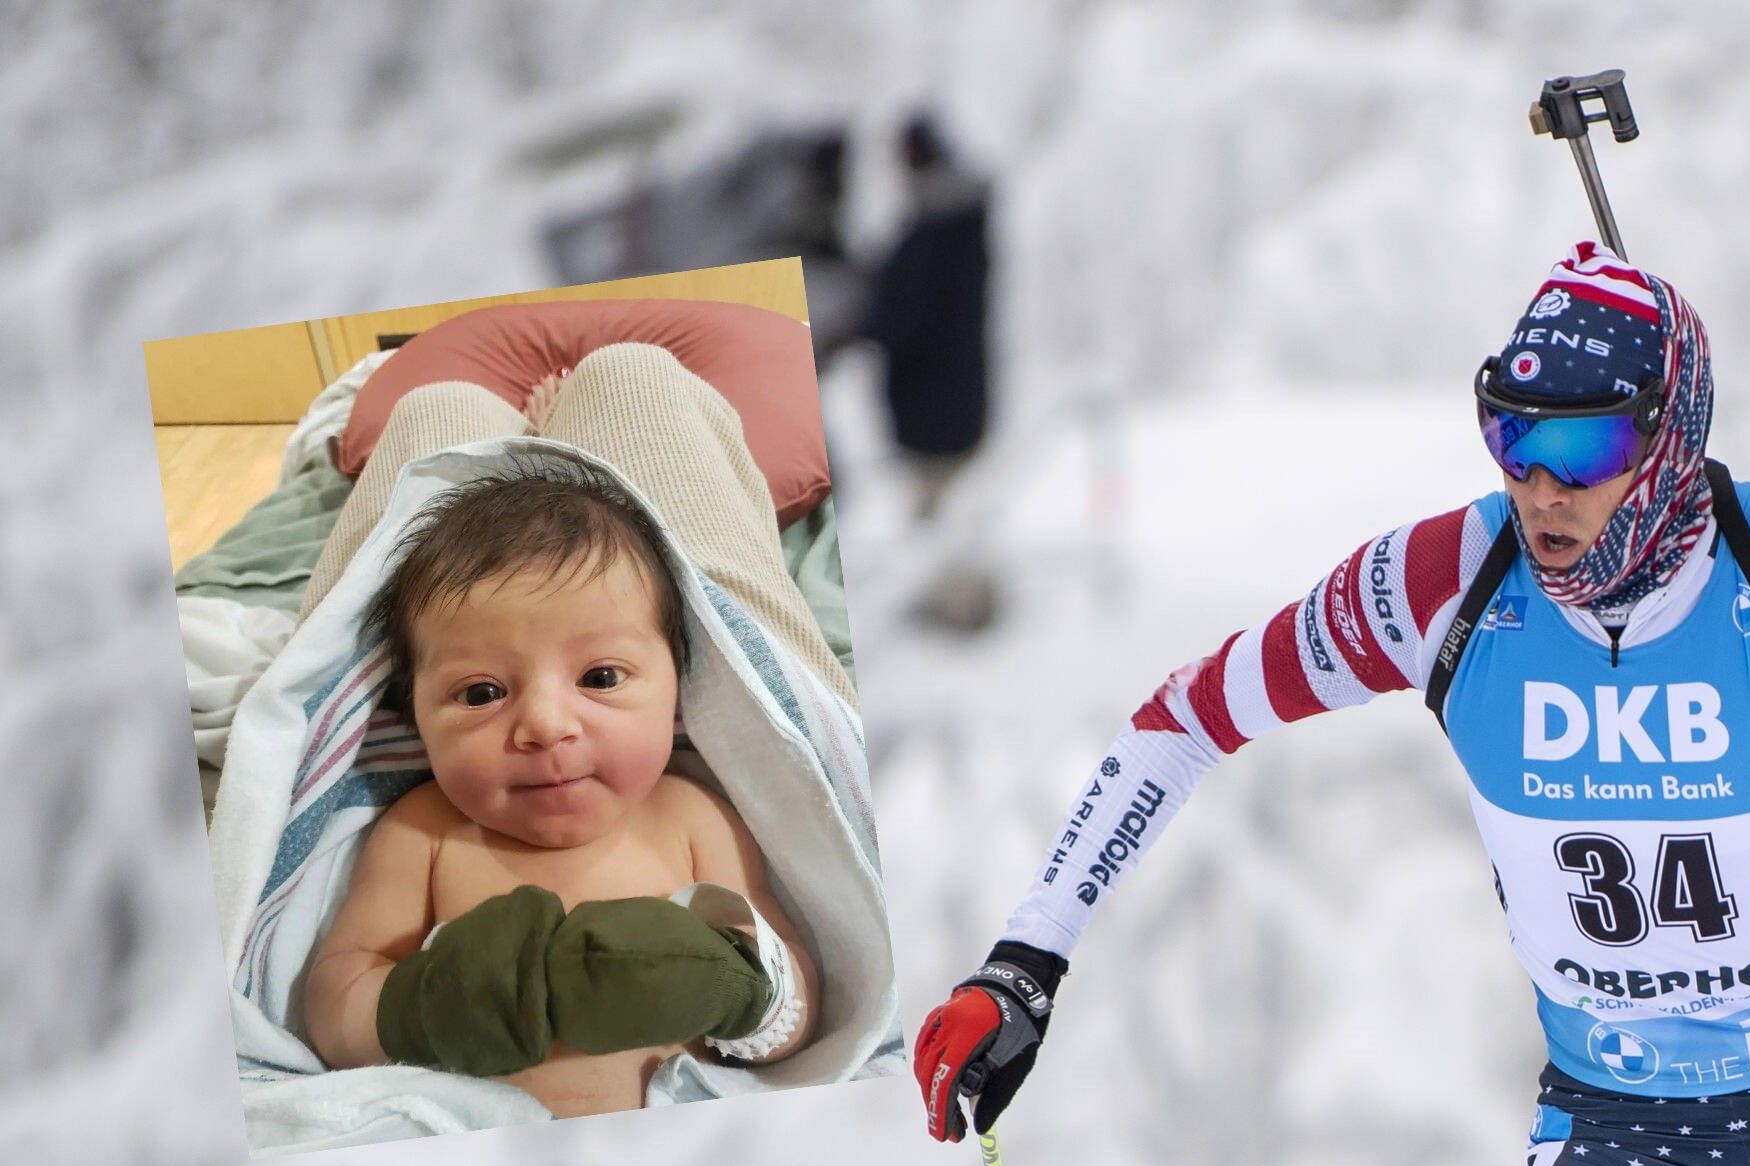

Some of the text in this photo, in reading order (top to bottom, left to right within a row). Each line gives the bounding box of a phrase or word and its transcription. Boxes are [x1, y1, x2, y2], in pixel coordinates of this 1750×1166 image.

[1508, 328, 1610, 357] IENS
[1438, 617, 1472, 670] biatar
[1523, 681, 1731, 763] DKB
[1523, 772, 1734, 800] Das kann Bank
[1043, 779, 1103, 887] ARIENS
[1088, 779, 1166, 886] maloja
[1553, 832, 1740, 948] 34
[1670, 1055, 1743, 1084] THE
